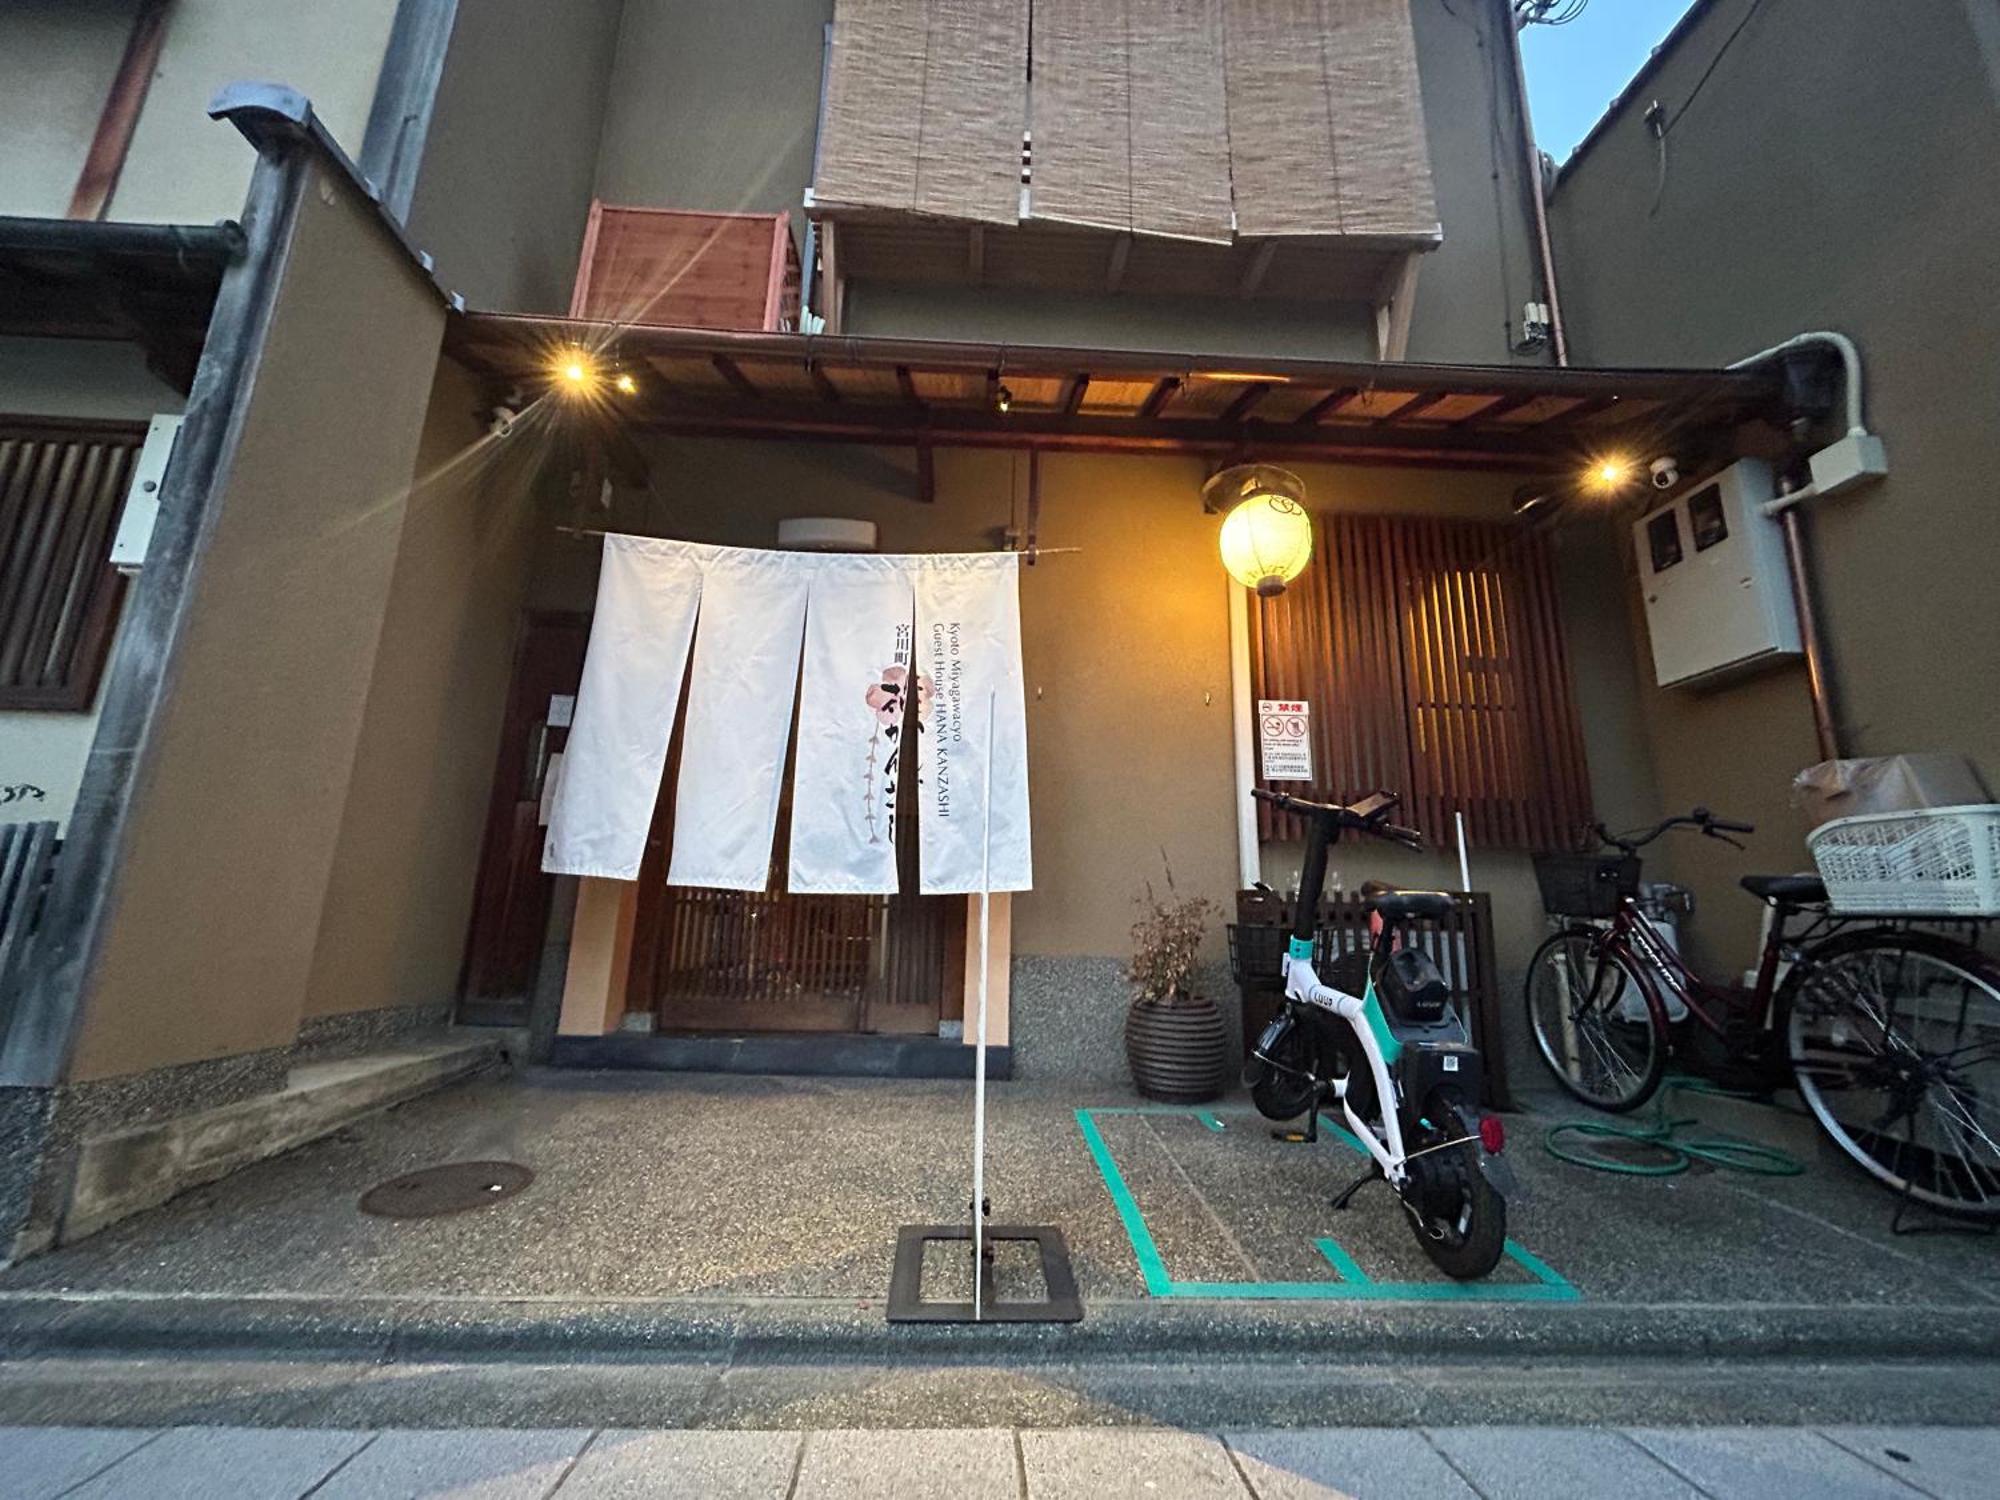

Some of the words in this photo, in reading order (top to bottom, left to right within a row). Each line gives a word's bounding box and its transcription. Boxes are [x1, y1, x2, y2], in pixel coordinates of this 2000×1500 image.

[933, 623, 945, 657] Guest
[947, 622, 961, 654] Kyoto
[934, 660, 945, 700] House
[948, 658, 962, 742] Miyagawacyo
[935, 702, 947, 743] HANA
[936, 748, 950, 817] KANZASHI
